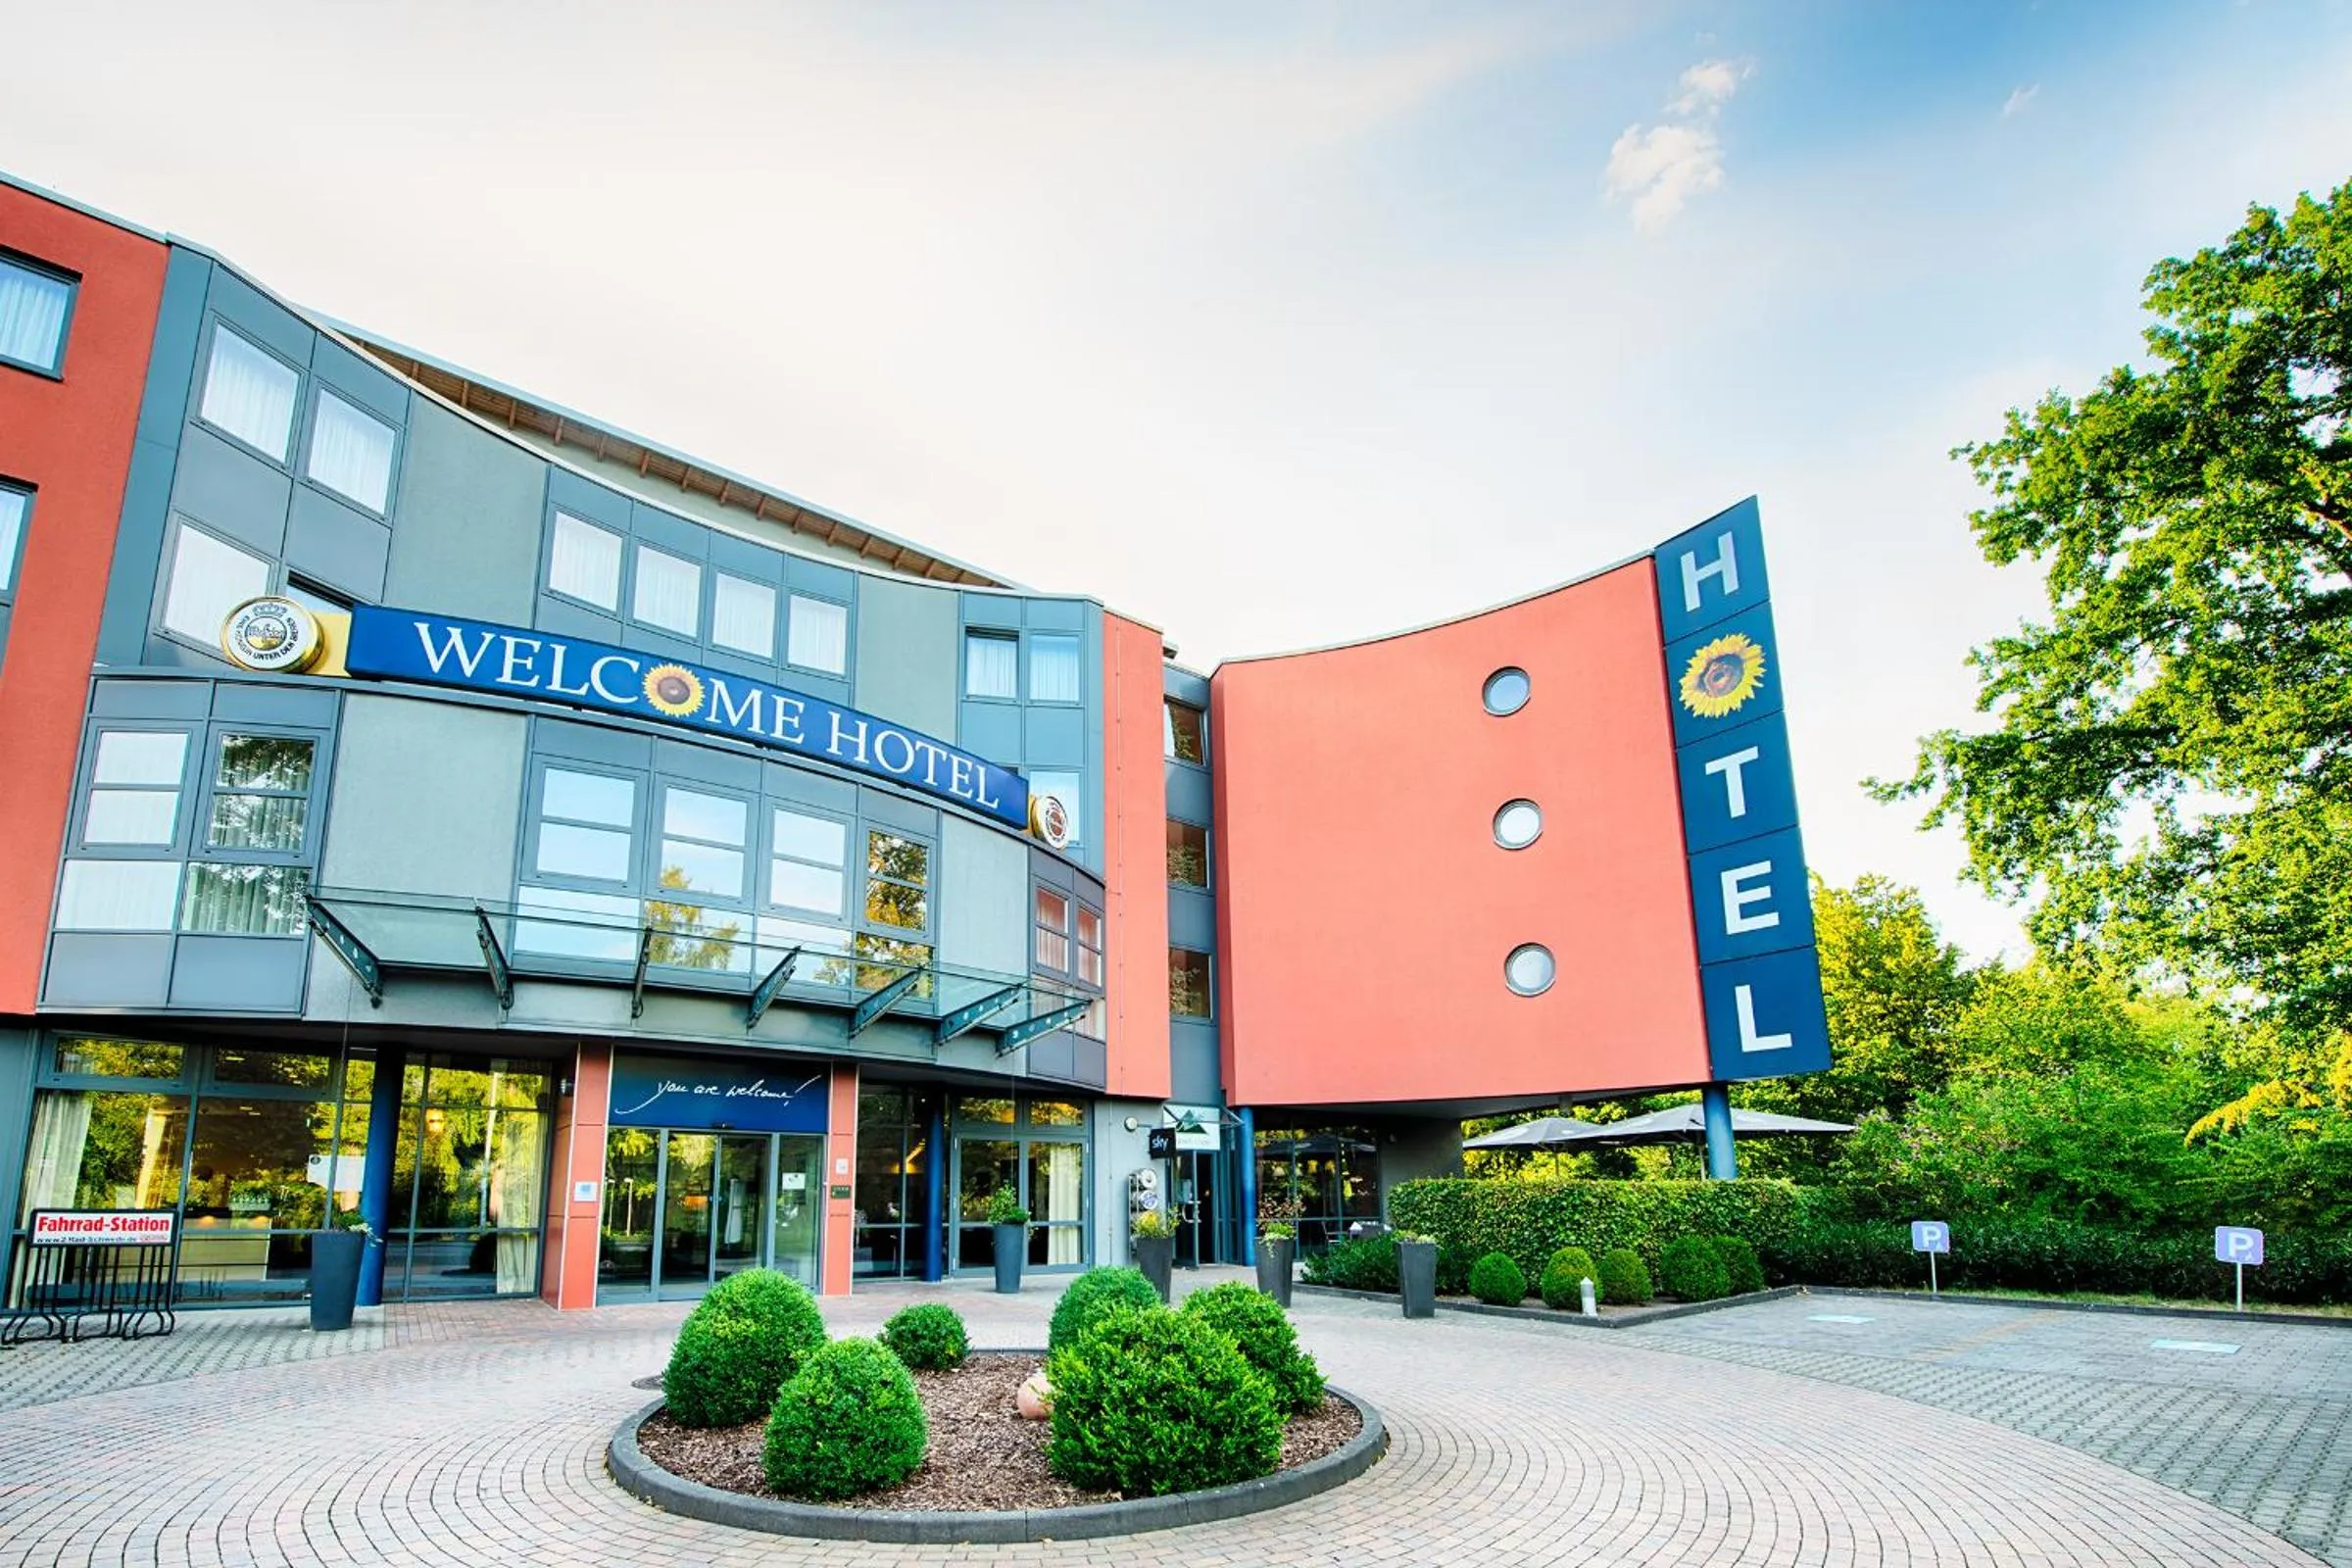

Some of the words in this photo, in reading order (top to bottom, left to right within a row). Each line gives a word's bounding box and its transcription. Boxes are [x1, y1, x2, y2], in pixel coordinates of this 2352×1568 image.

[826, 711, 1000, 809] HOTEL
[694, 1084, 721, 1096] are
[1152, 1135, 1169, 1152] sky
[37, 1215, 171, 1232] Fahrrad-Station
[1923, 1228, 1941, 1248] P
[2228, 1232, 2254, 1257] P
